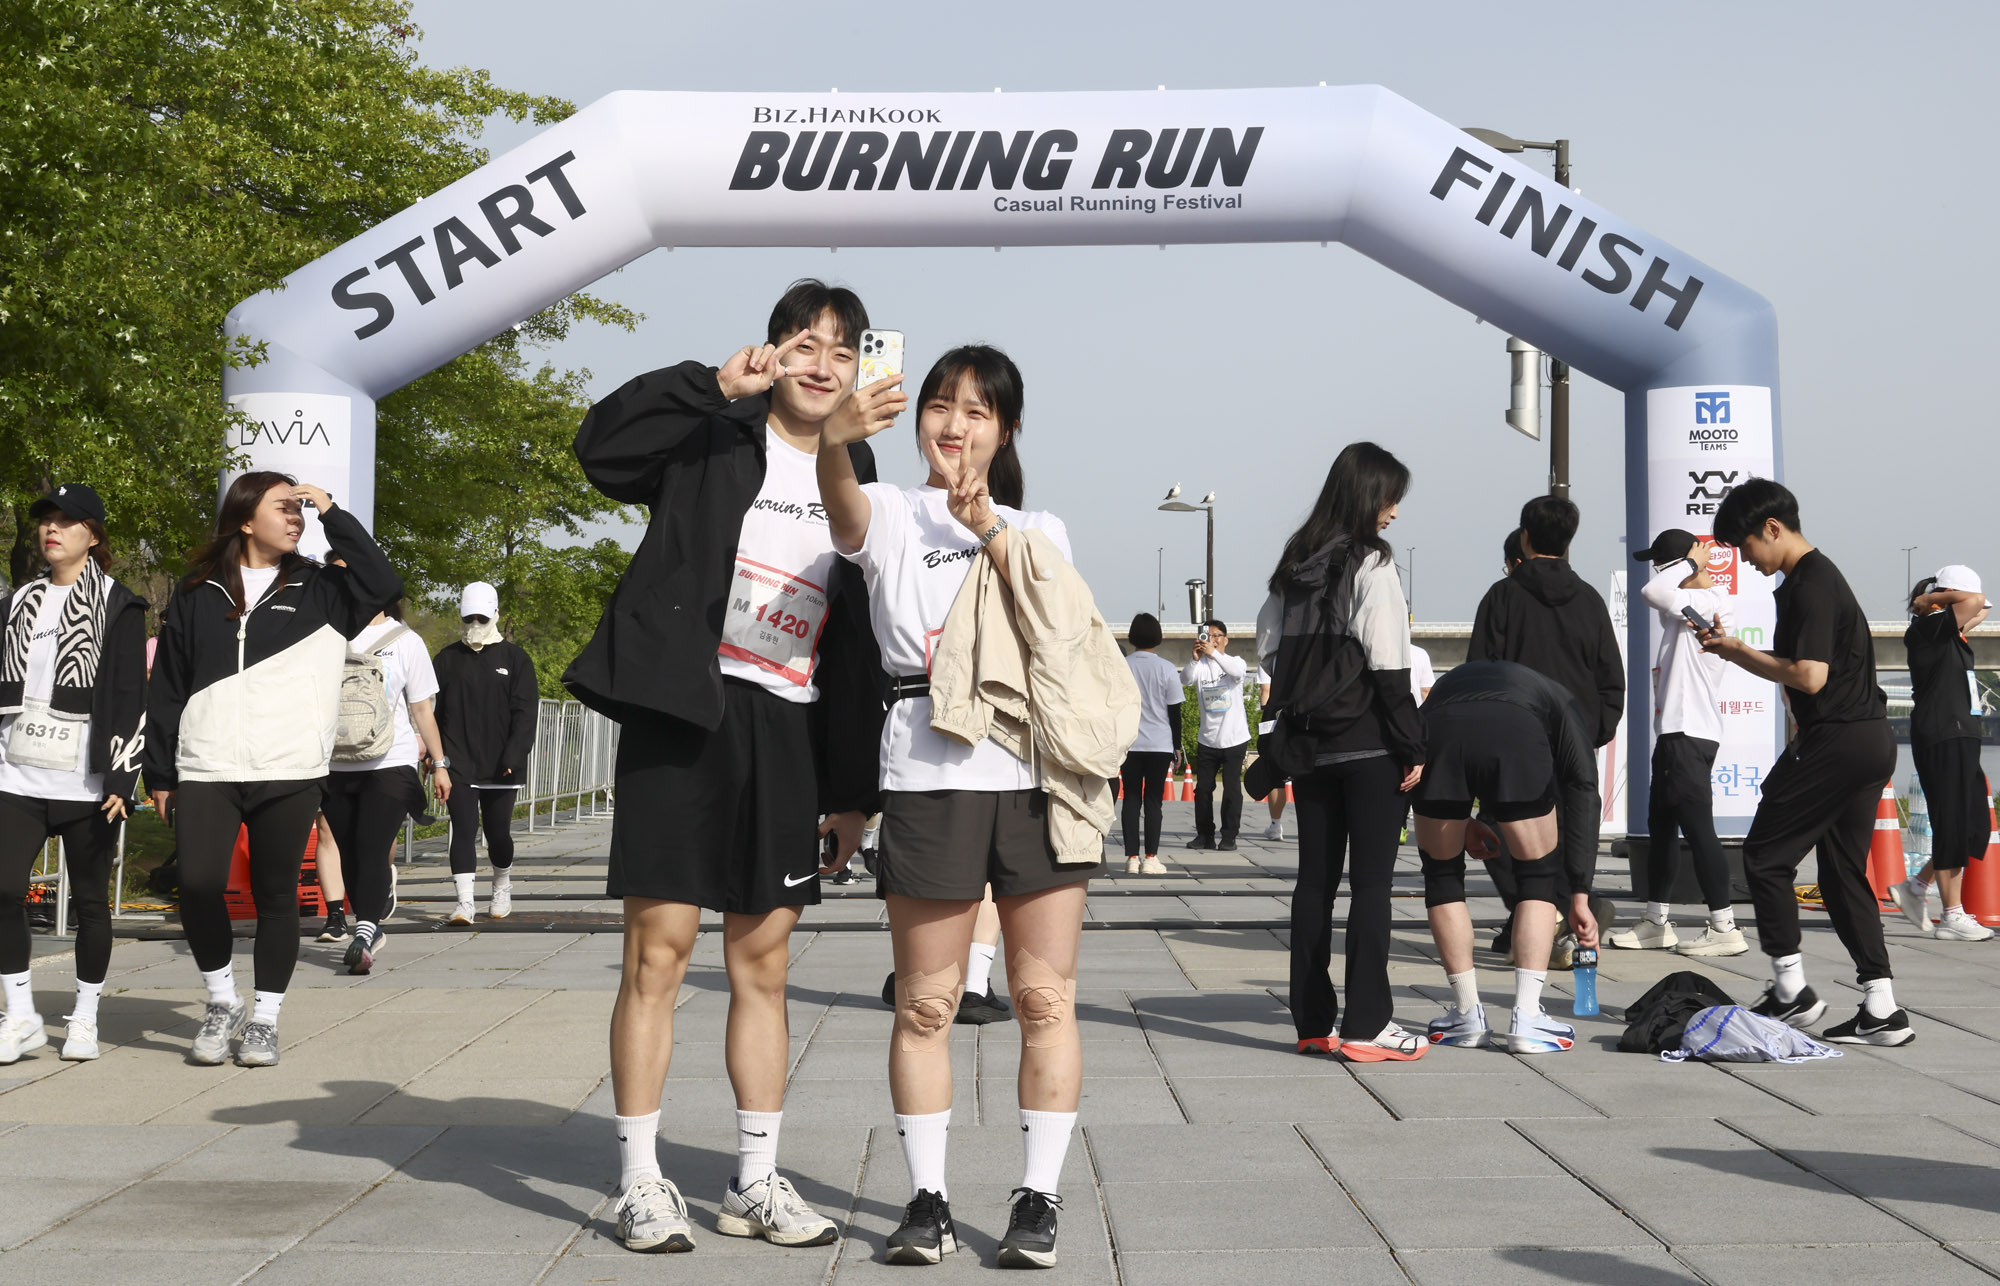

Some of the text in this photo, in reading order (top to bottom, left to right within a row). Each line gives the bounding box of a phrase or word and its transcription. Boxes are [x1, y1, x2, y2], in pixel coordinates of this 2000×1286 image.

[728, 126, 1265, 191] BURNING RUN
[993, 193, 1242, 213] Casual Running Festival
[331, 150, 587, 341] START
[1429, 146, 1704, 332] FINISH
[1689, 429, 1738, 440] MOOTO
[754, 499, 804, 520] urning
[1686, 503, 1721, 515] RE
[923, 546, 980, 569] Burni
[738, 569, 780, 588] BURNING
[781, 583, 799, 595] RUN
[1710, 574, 1733, 582] OOD
[805, 594, 824, 608] 10km
[733, 598, 809, 639] M 1420
[16, 722, 70, 740] W 6315
